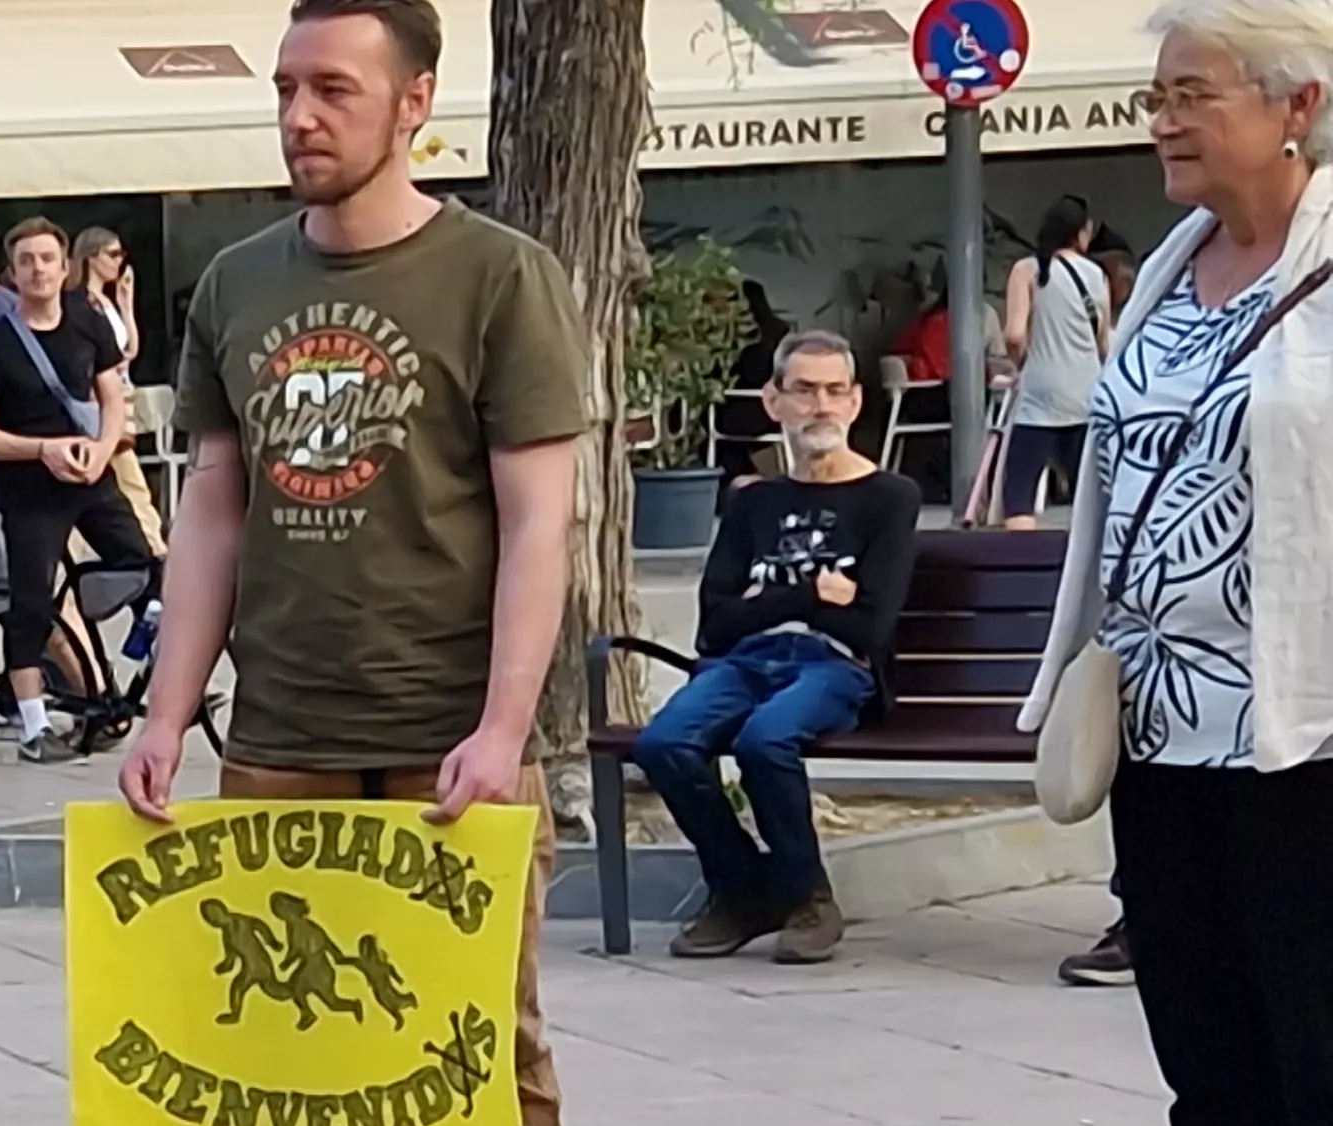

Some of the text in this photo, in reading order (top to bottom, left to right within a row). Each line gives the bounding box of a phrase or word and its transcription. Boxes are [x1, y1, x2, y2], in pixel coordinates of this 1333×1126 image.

[639, 115, 866, 151] STAURANTE
[924, 104, 1071, 137] GANJA
[248, 302, 422, 377] AUTHENTIC
[244, 379, 426, 458] Superior
